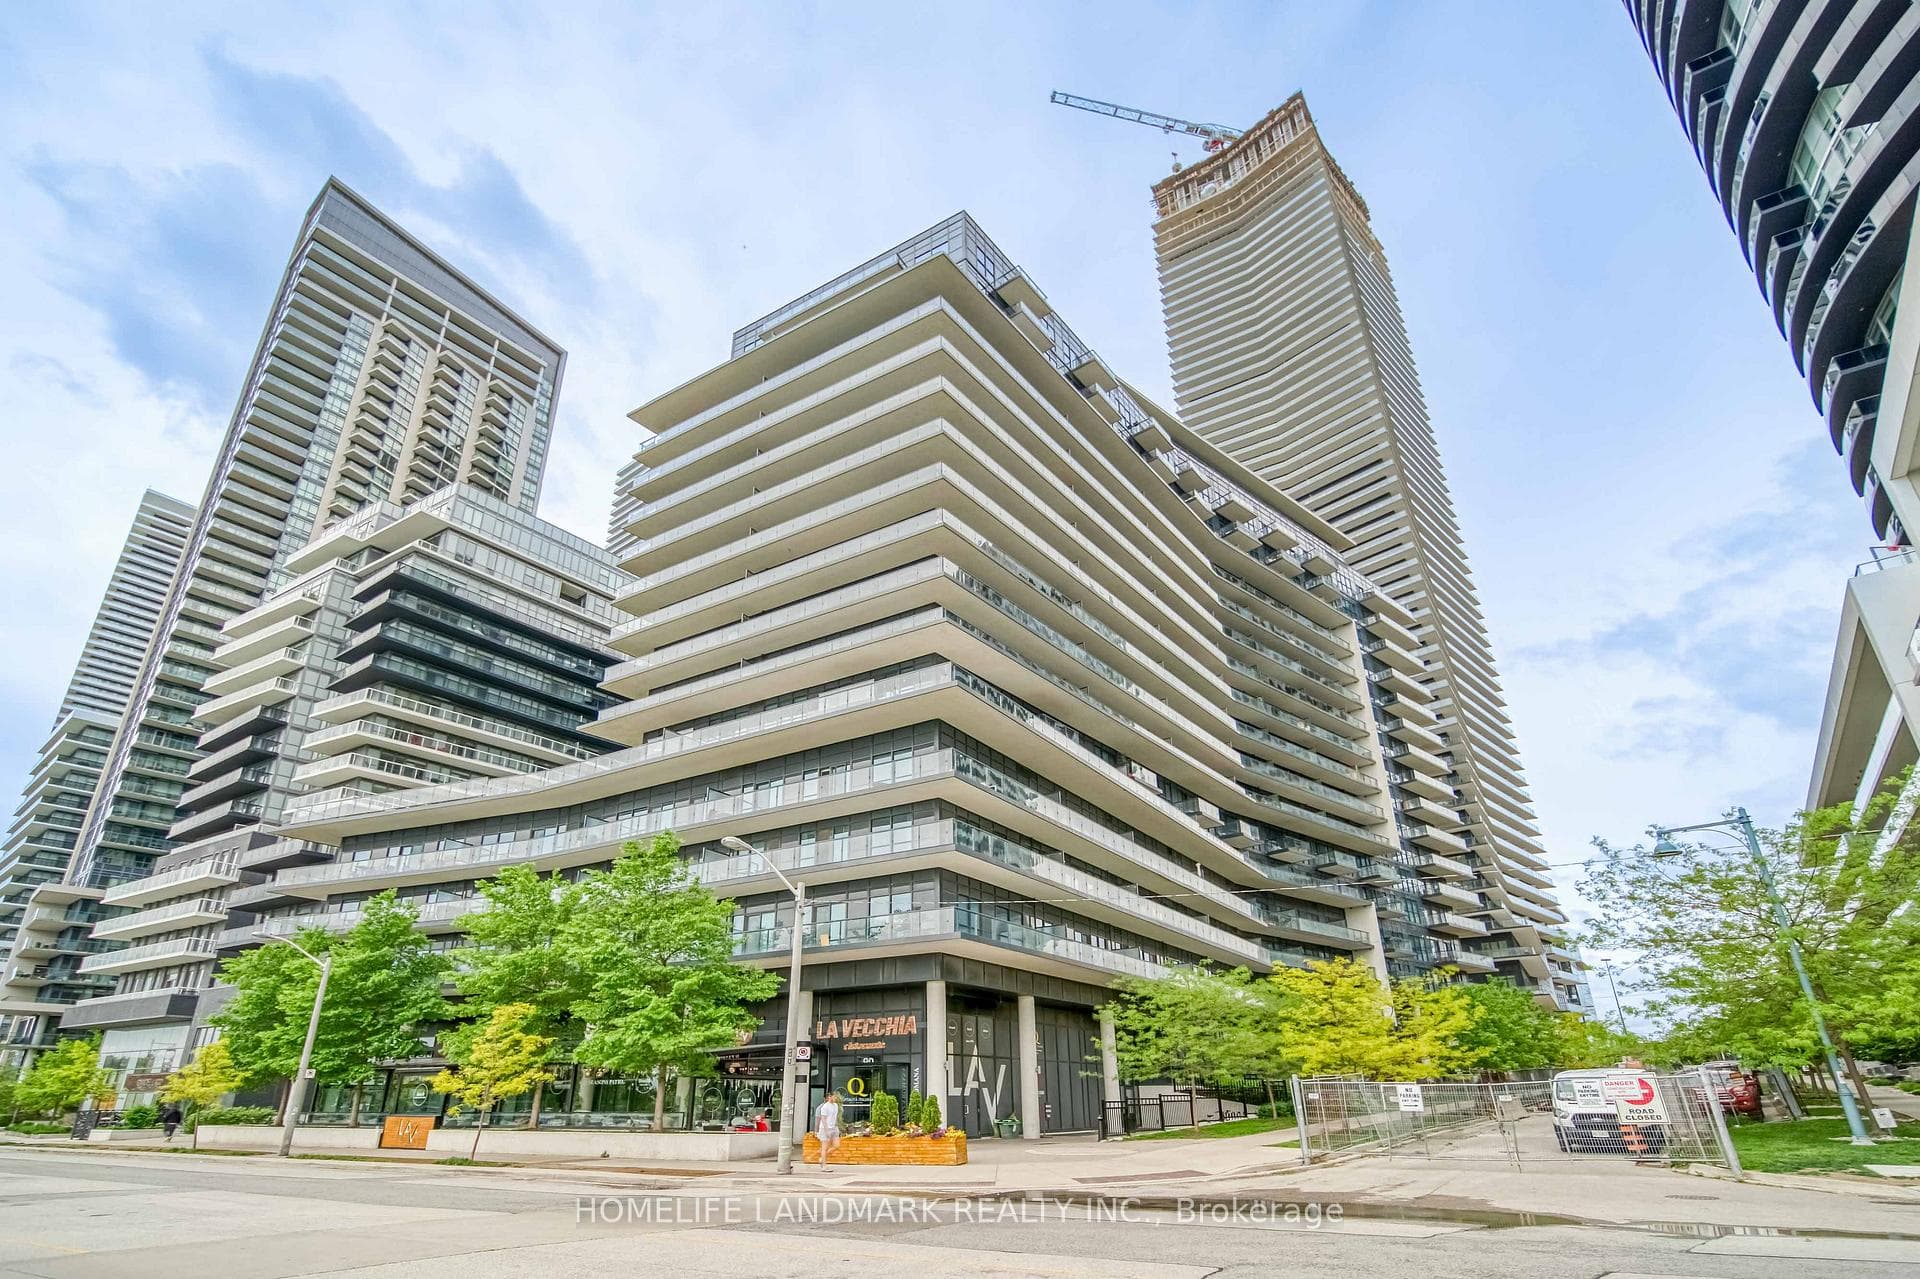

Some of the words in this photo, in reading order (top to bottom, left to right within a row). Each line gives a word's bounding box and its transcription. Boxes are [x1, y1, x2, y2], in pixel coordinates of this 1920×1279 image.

[816, 1020, 839, 1039] LA
[842, 1015, 917, 1038] VECCHIA
[847, 1077, 869, 1097] Q
[947, 1041, 1006, 1127] LAV
